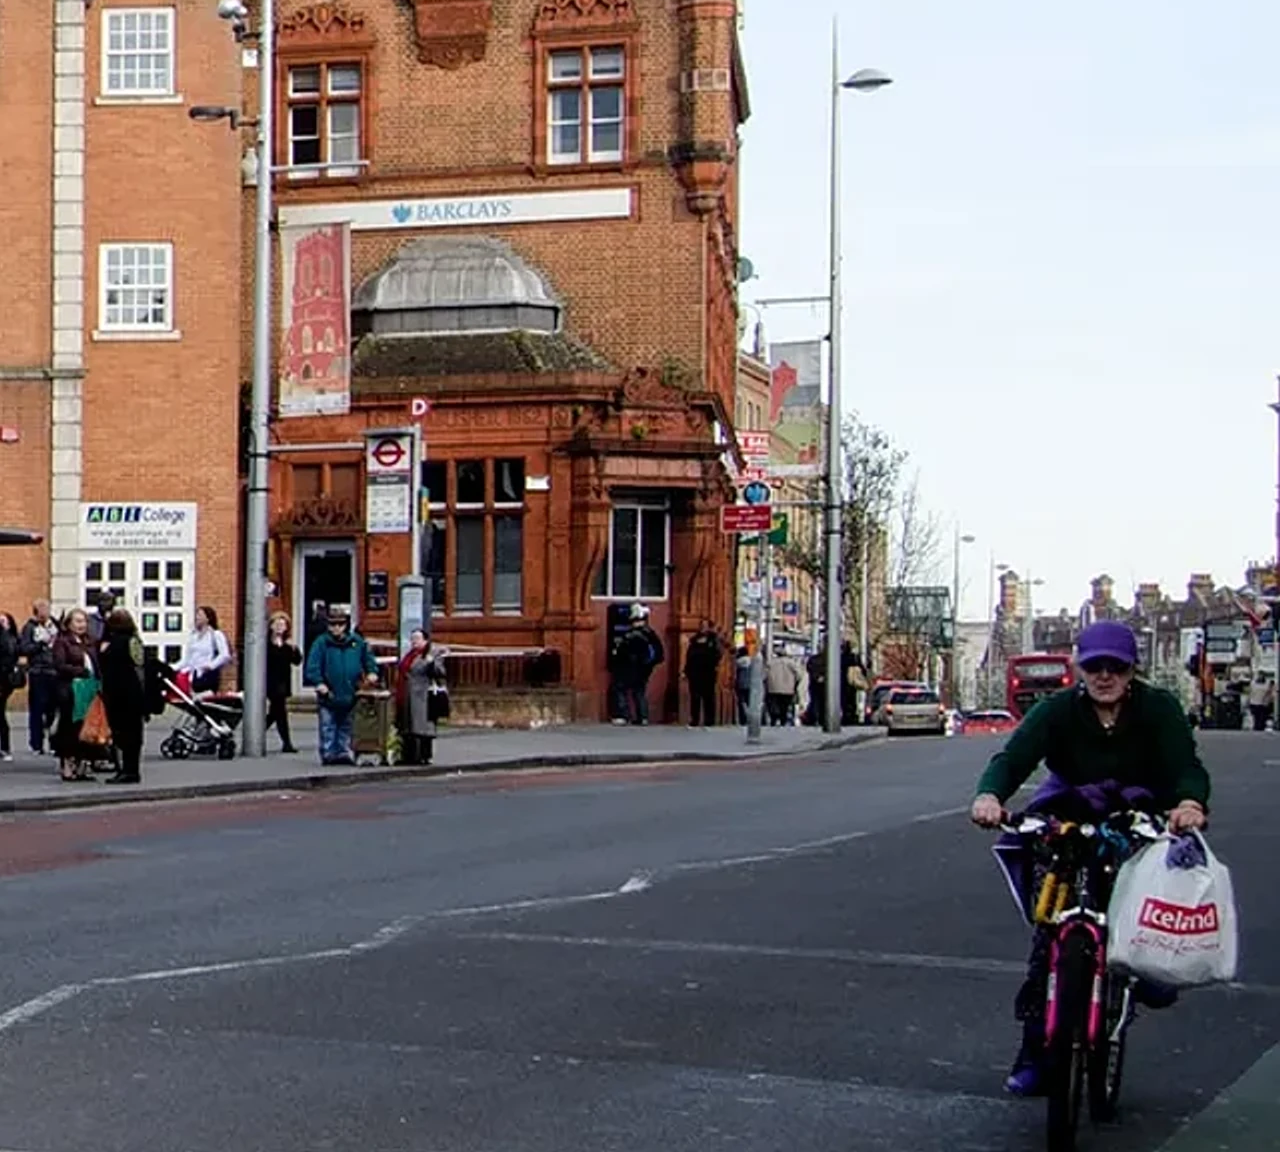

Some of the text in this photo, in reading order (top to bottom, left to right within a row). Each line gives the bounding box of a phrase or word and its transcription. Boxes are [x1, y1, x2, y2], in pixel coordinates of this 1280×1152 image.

[416, 200, 512, 221] BARCLAYS
[411, 399, 426, 416] D
[143, 507, 186, 525] College
[1142, 902, 1215, 931] Iceland
